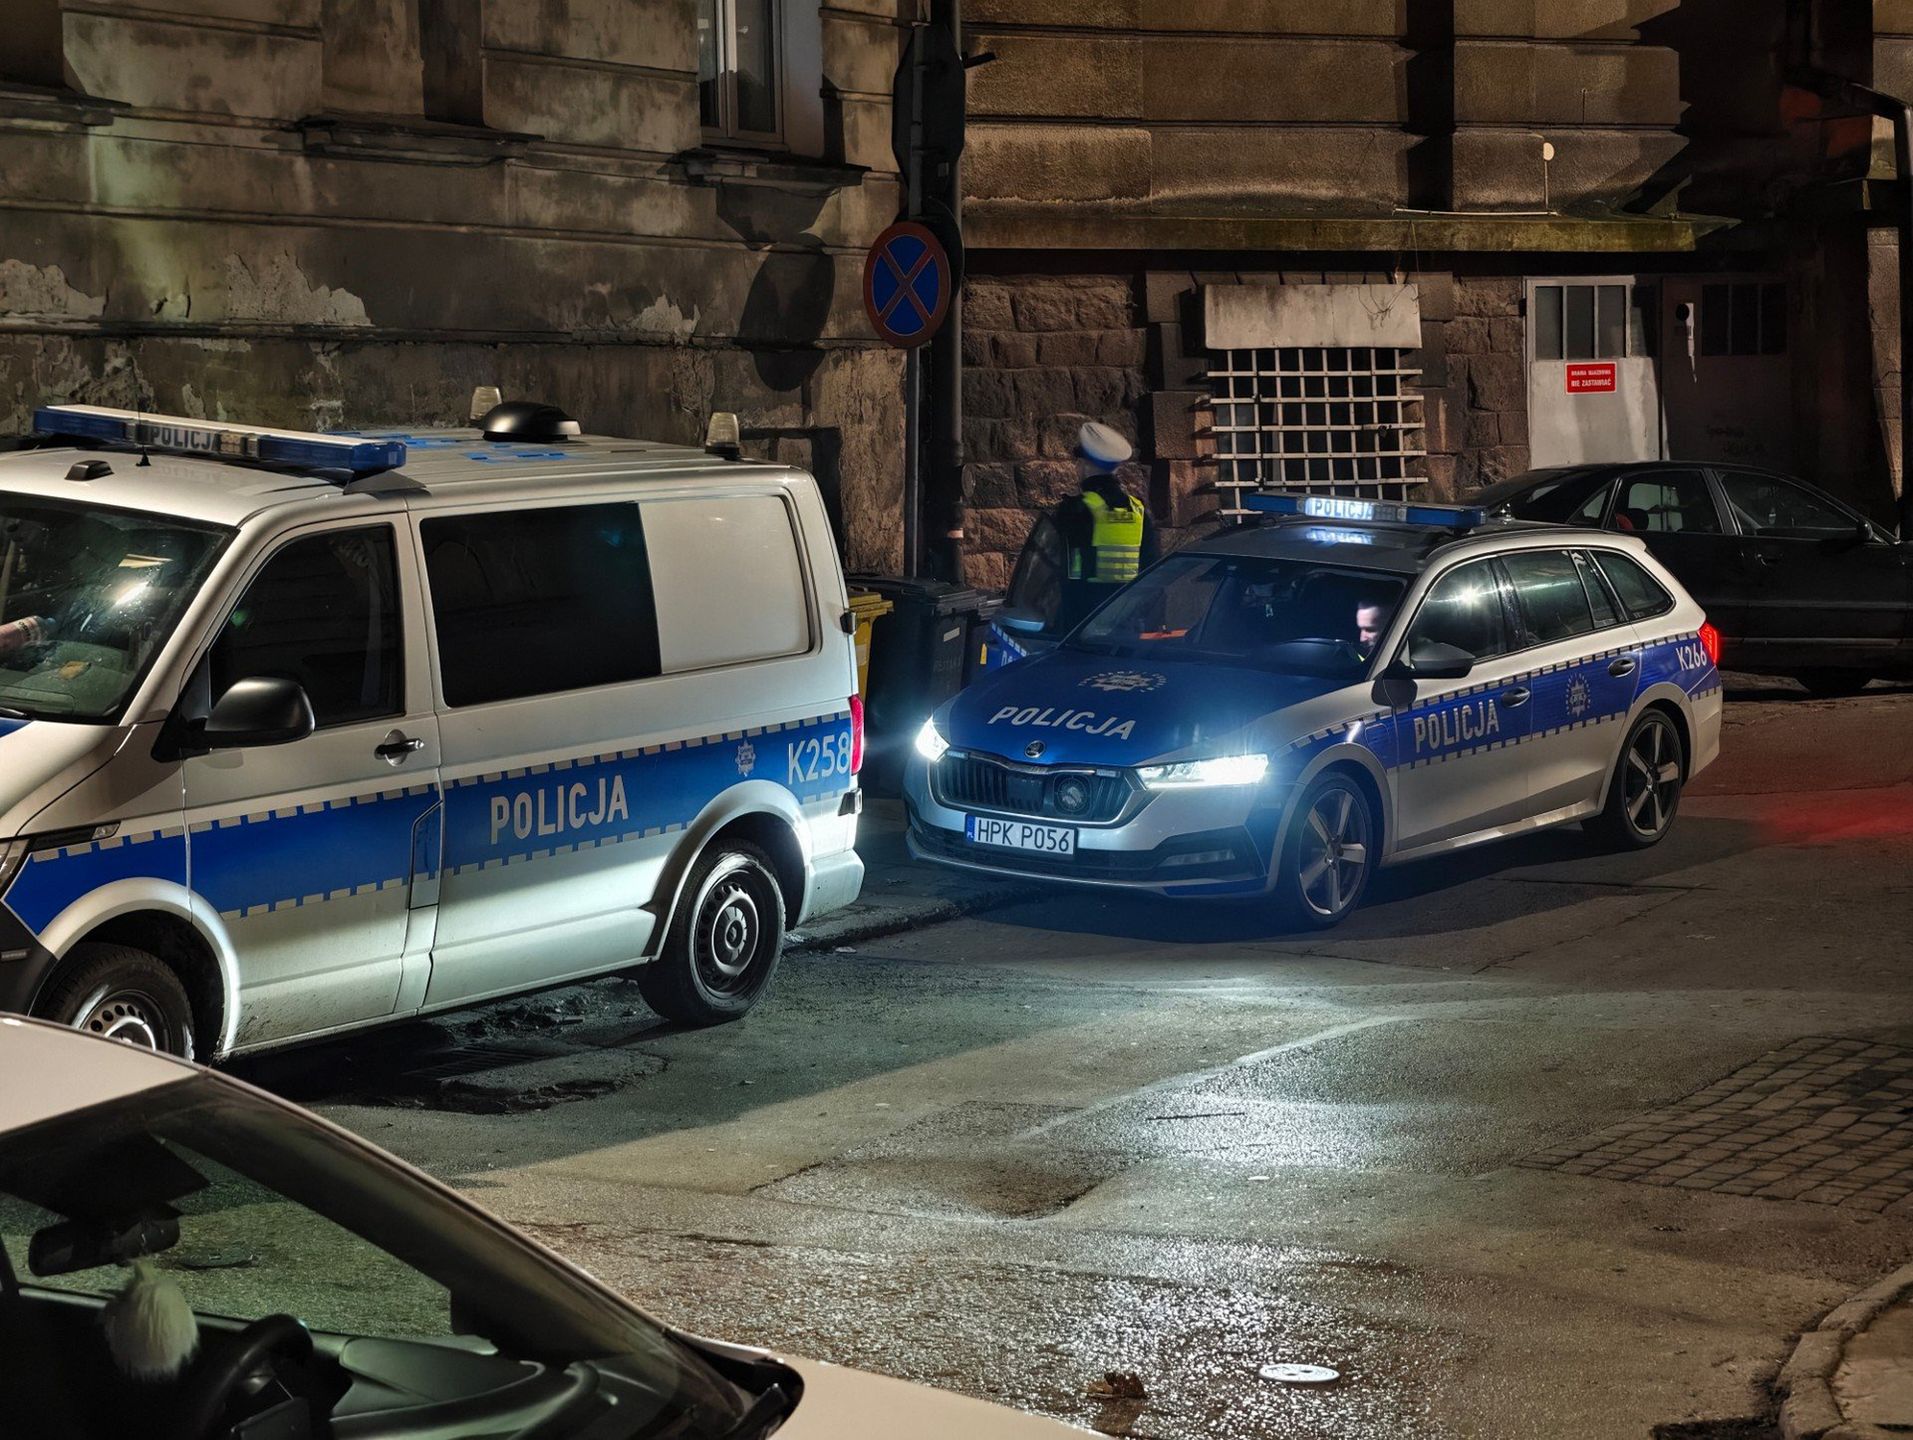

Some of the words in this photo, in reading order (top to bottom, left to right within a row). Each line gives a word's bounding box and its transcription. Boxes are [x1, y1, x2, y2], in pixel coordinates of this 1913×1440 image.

[1315, 500, 1373, 519] POLICJA
[1675, 641, 1707, 671] K266
[987, 705, 1137, 740] POLICJA
[1413, 699, 1500, 753] POLICJA
[787, 731, 851, 785] K258
[490, 775, 629, 844] POLICJA
[978, 819, 1014, 845] HPK
[1021, 825, 1070, 852] P056
